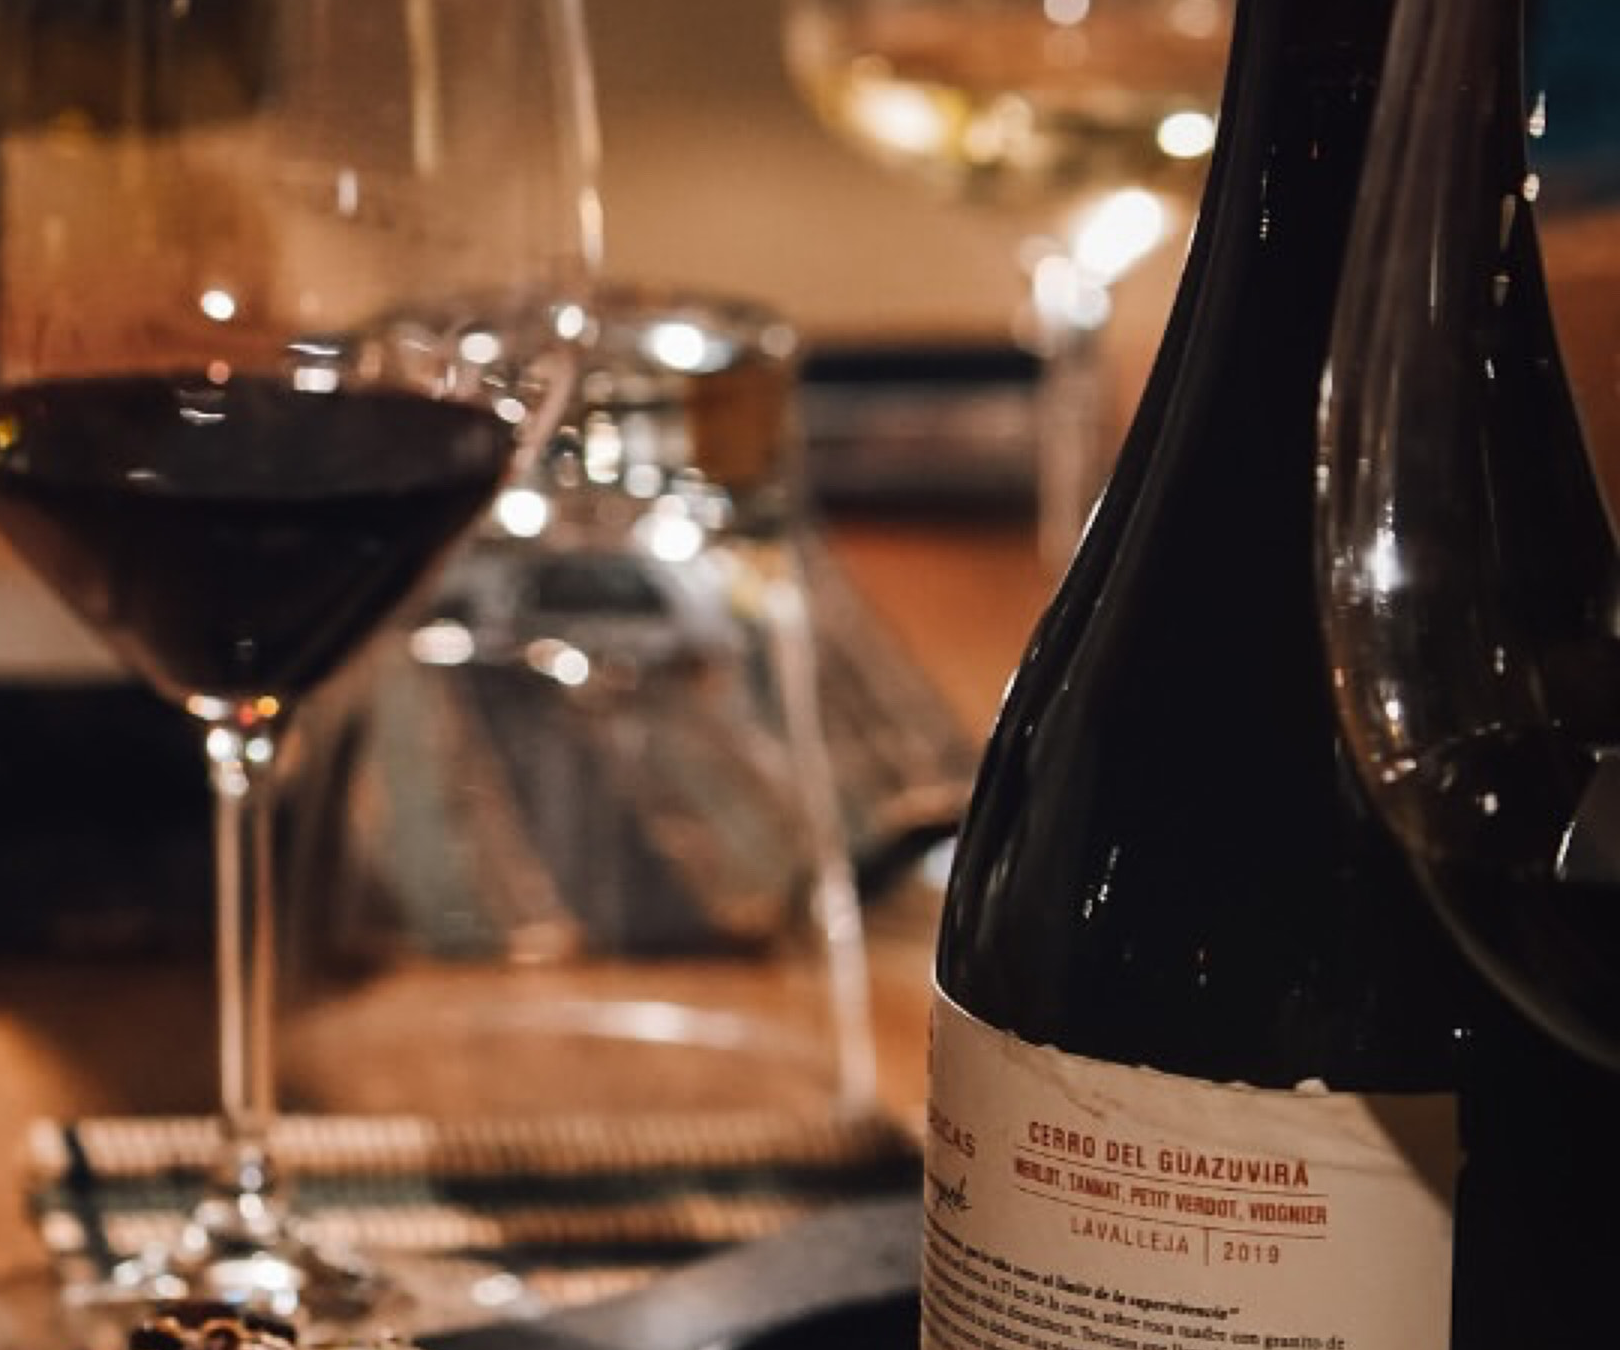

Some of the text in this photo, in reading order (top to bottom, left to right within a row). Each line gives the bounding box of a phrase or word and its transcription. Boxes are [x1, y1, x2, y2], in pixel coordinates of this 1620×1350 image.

[1028, 1120, 1096, 1159] CERRO
[1106, 1139, 1147, 1169] DEL
[1130, 1186, 1171, 1209] PETIT
[1175, 1193, 1244, 1220] VERDOT,
[1249, 1202, 1328, 1225] VIOGNIER
[1069, 1216, 1189, 1255] LAVALLEJA
[1223, 1241, 1280, 1265] 2019
